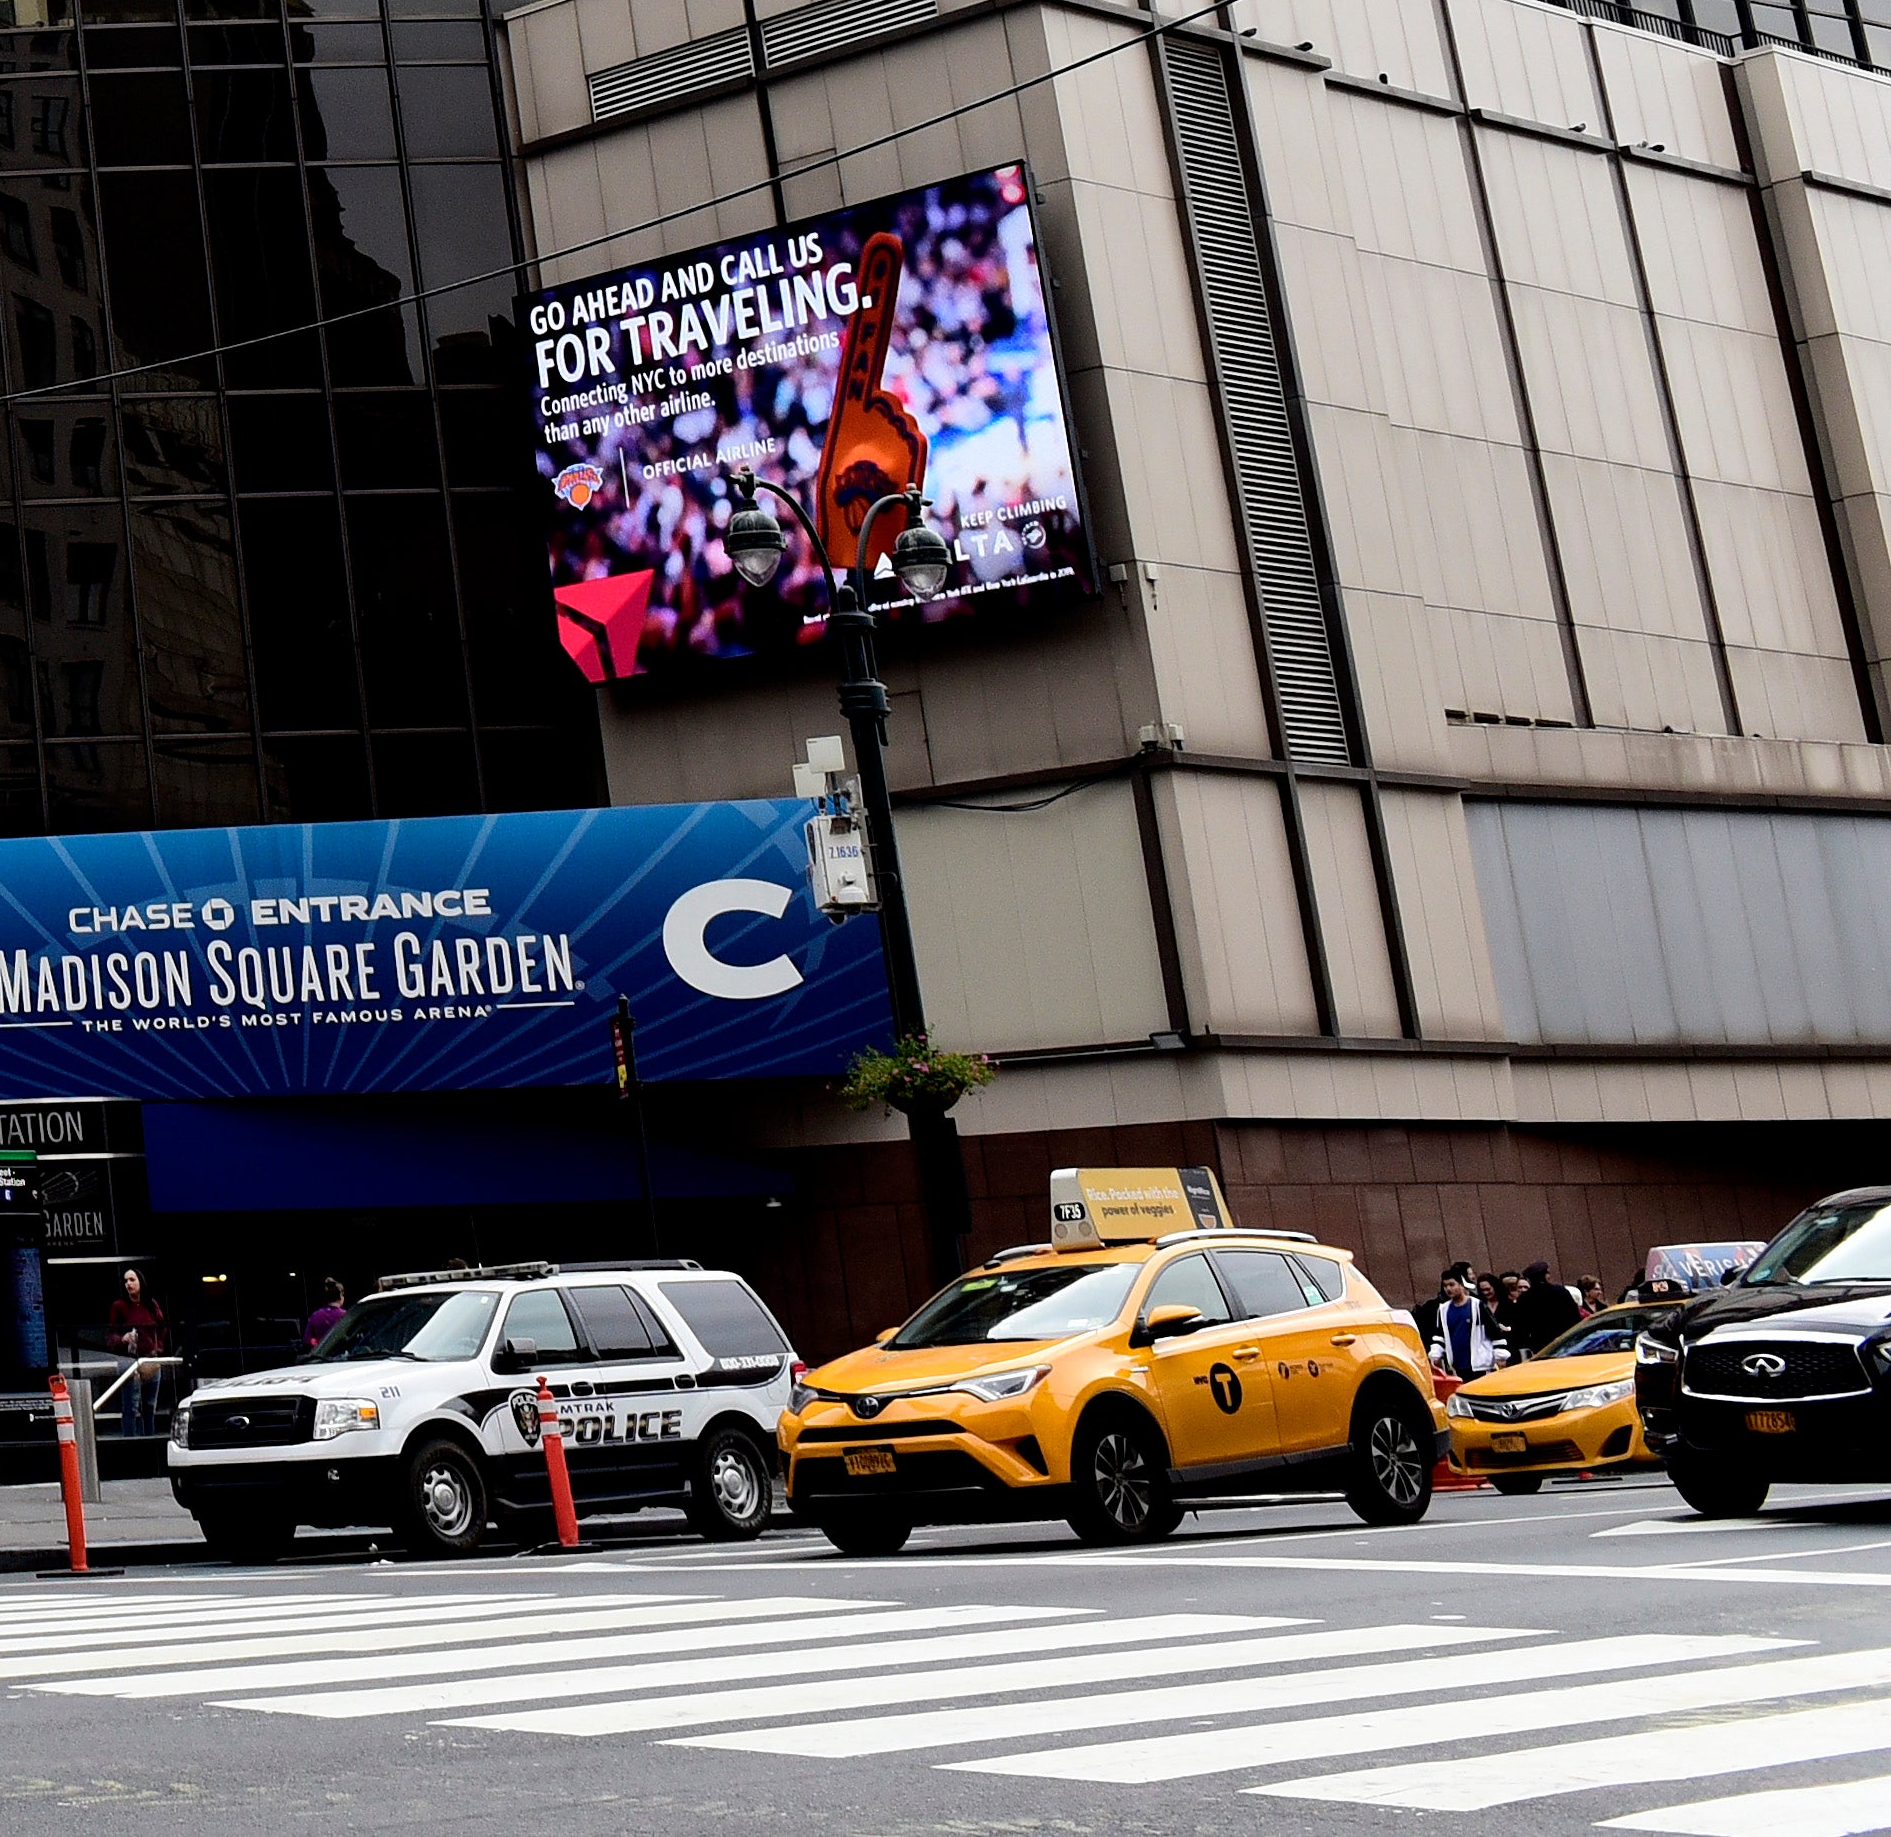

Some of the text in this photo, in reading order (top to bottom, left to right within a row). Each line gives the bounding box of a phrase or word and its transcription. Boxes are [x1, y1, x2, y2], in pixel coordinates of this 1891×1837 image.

[530, 232, 823, 336] GO AHEAD AND CALL US
[535, 327, 615, 389] FOR
[619, 262, 873, 366] TRAVELING.
[540, 331, 840, 417] Connecting NYC to more destinations
[544, 391, 717, 444] than any other airline.
[642, 437, 777, 480] OFFICIAL AIRLINE
[960, 495, 1068, 529] KEEP CLIMBING
[953, 530, 1014, 563] LTA
[69, 888, 492, 934] CHASE ENTRANCE
[662, 878, 805, 1000] C
[208, 934, 375, 1009] SQUARE
[83, 1004, 487, 1032] THE WORLD'S MOST FAMOUS ARENA
[5, 1190, 13, 1201] E
[1086, 1188, 1110, 1202] Rice.
[1110, 1187, 1144, 1201] Packed
[1144, 1186, 1163, 1200] with
[1163, 1186, 1179, 1200] the
[1102, 1202, 1175, 1218] power of veggies
[379, 1386, 401, 1399] 211
[1193, 1373, 1232, 1407] NYC T
[556, 1401, 615, 1414] MTRAK
